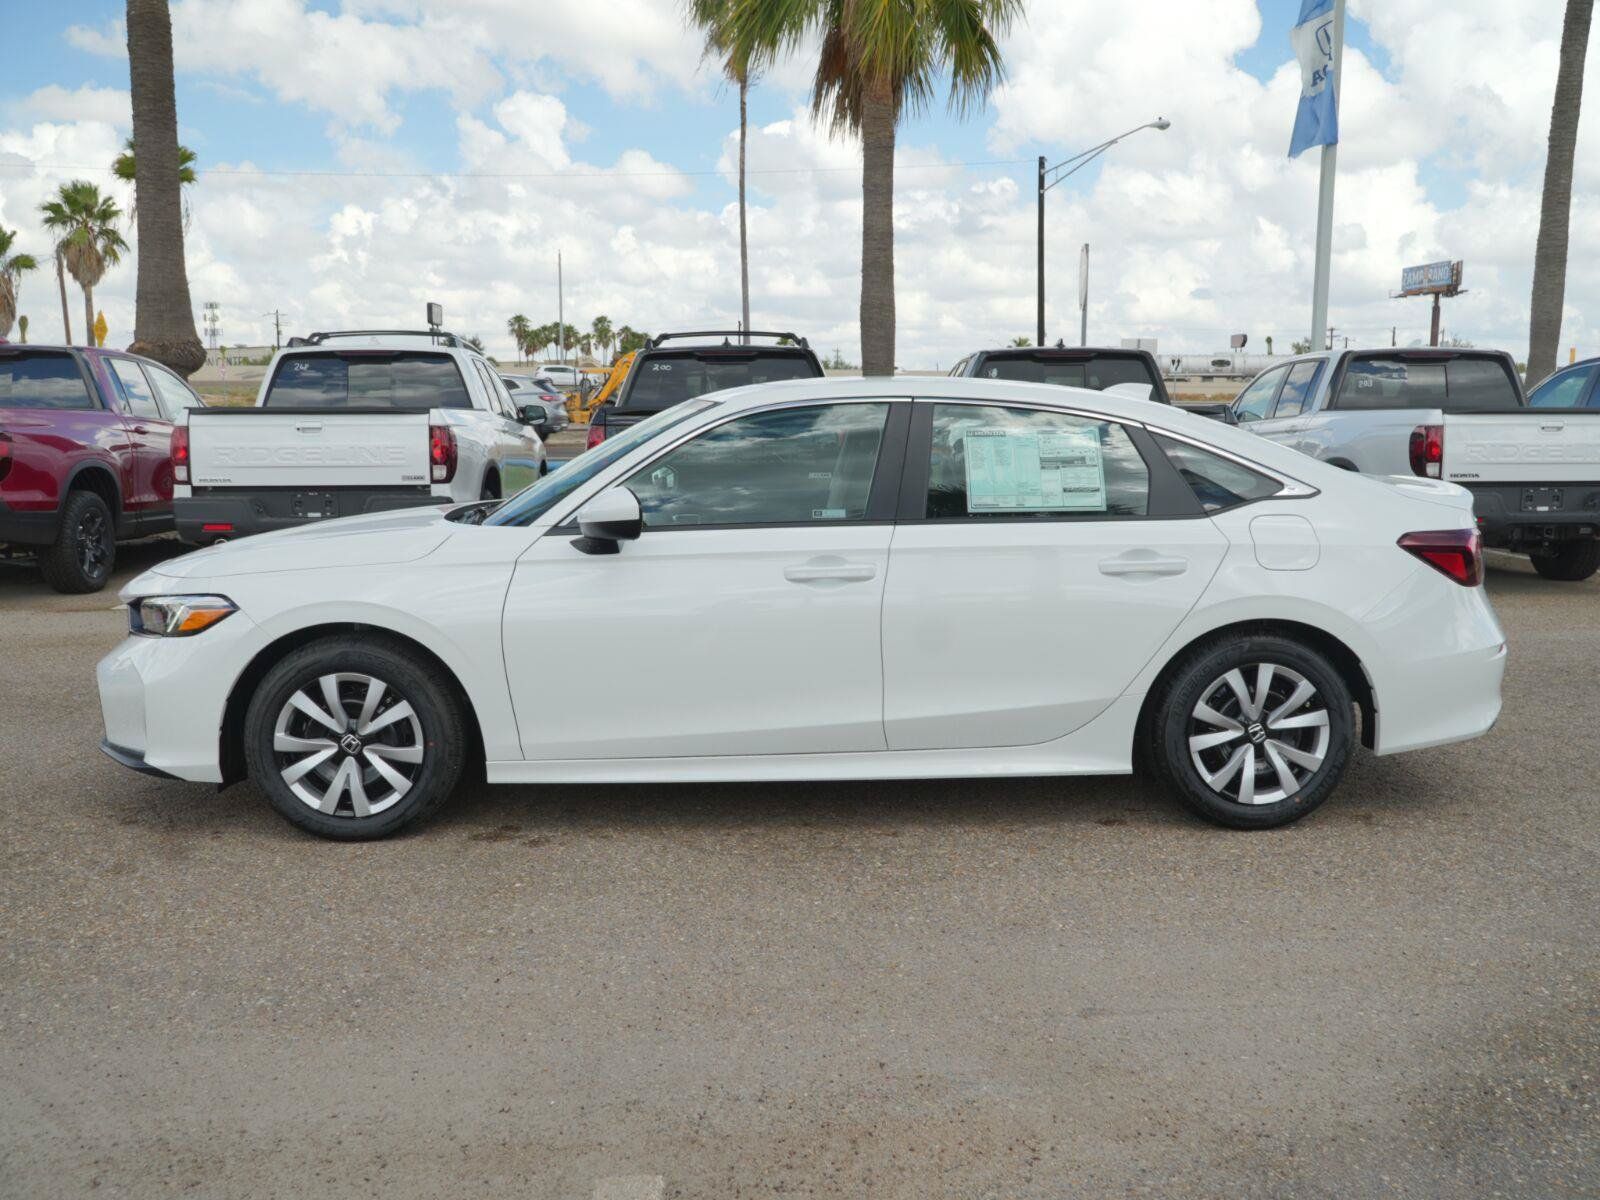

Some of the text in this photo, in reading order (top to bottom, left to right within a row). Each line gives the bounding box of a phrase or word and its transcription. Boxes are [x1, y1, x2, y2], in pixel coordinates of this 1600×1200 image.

[652, 363, 673, 371] 200
[211, 445, 407, 464] RIDGELINE
[1464, 441, 1600, 461] RIDGELI
